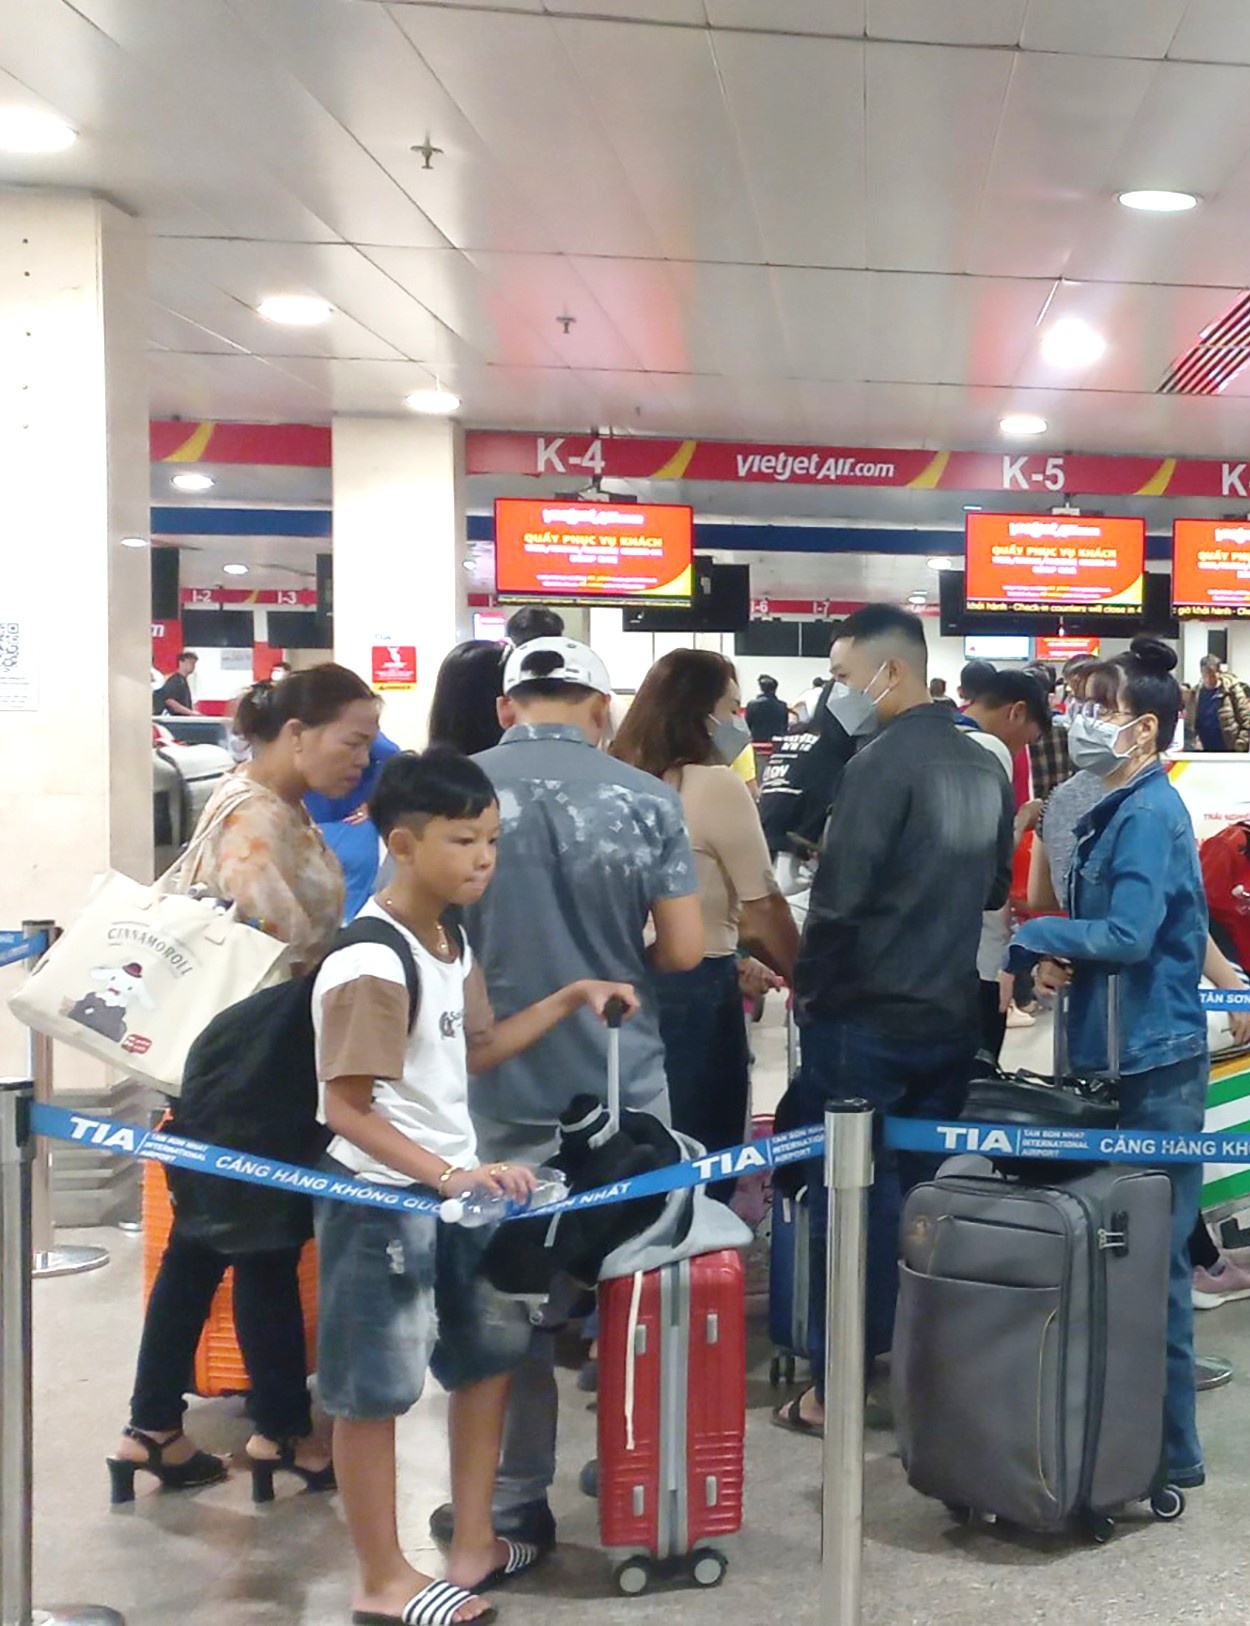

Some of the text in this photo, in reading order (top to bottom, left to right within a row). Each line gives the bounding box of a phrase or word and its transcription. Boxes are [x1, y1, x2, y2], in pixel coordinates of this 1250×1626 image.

[536, 438, 606, 474] K-4
[1003, 456, 1064, 491] K-5
[70, 1116, 134, 1152] TIA
[937, 1126, 1013, 1153] TIA
[1161, 1135, 1217, 1155] HÀNG
[272, 1166, 328, 1191] HÀNG
[692, 1146, 766, 1180] TIA
